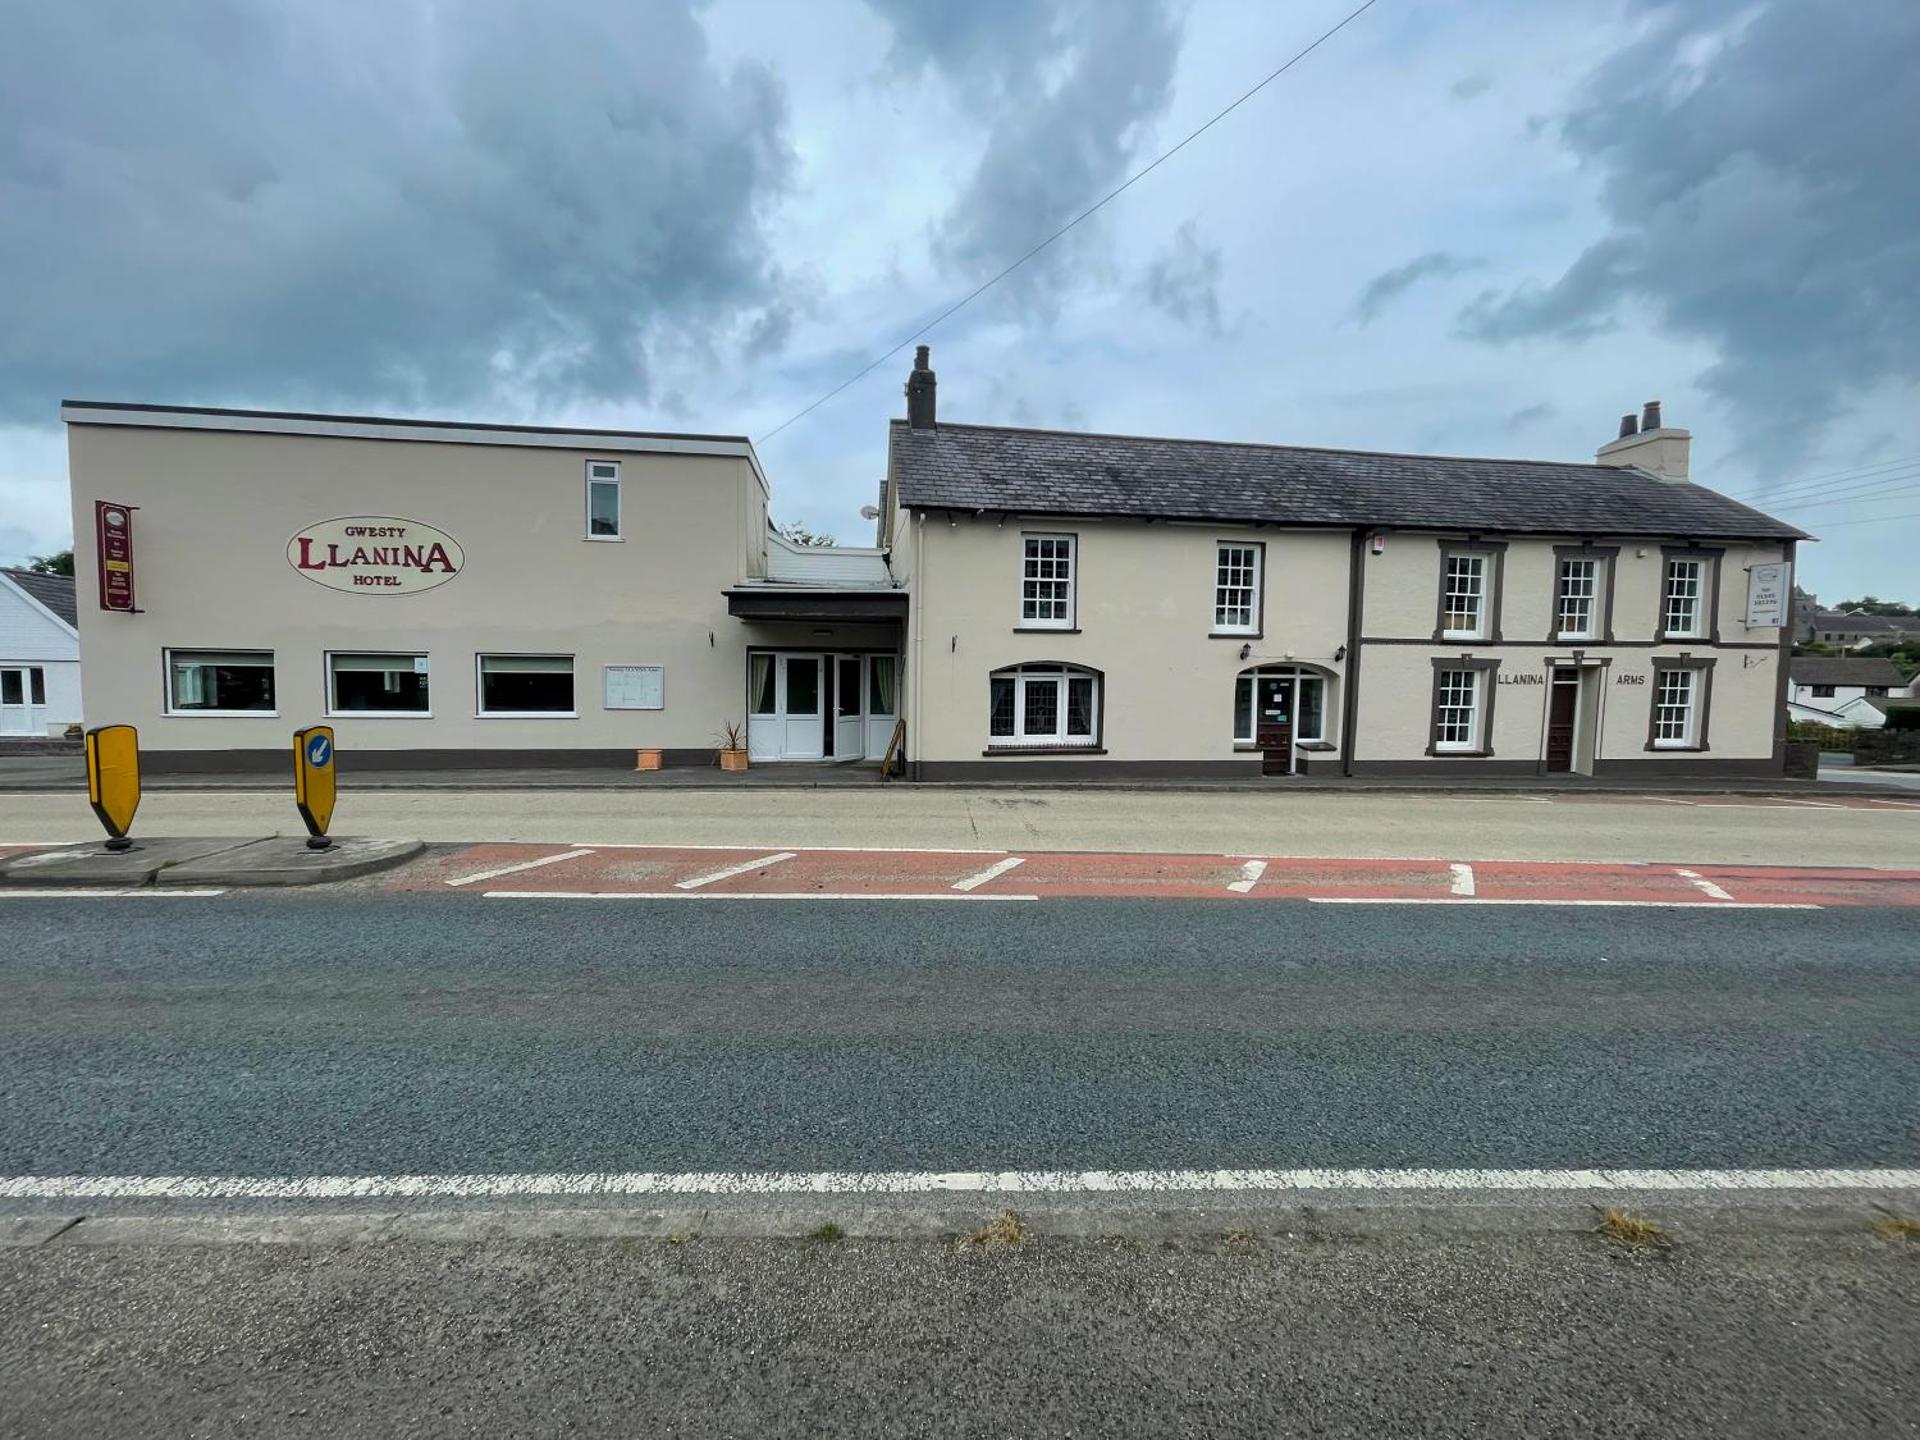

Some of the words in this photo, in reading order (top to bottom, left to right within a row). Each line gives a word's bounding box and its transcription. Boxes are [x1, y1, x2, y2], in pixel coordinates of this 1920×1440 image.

[345, 526, 405, 537] GWESTY
[298, 537, 456, 572] LLANINA
[353, 575, 401, 585] HOTEL
[1498, 674, 1543, 685] LLANINA
[1616, 675, 1645, 685] ARMS
